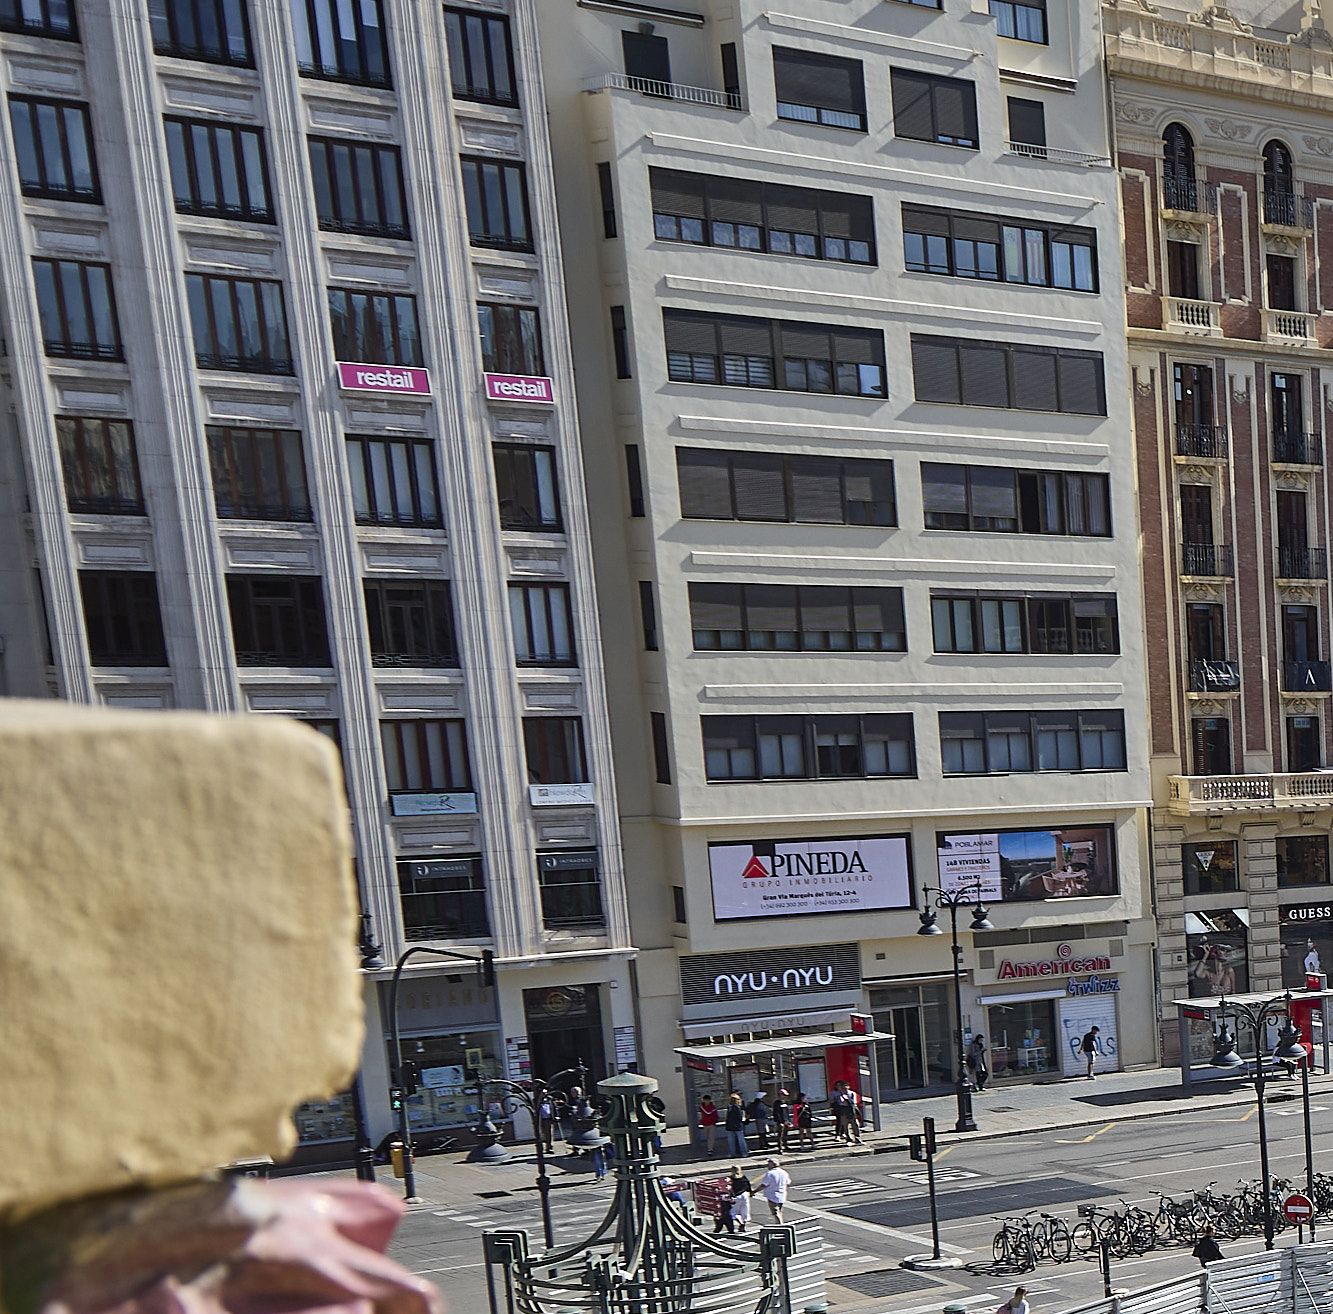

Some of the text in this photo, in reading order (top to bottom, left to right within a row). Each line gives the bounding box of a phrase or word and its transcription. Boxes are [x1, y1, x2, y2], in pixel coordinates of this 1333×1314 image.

[356, 370, 415, 389] restail
[493, 379, 547, 398] restail
[769, 850, 868, 877] PINEDA
[742, 875, 873, 888] GRUPO INMOBILIARIO
[1288, 906, 1331, 920] GUESS
[999, 952, 1111, 979] American
